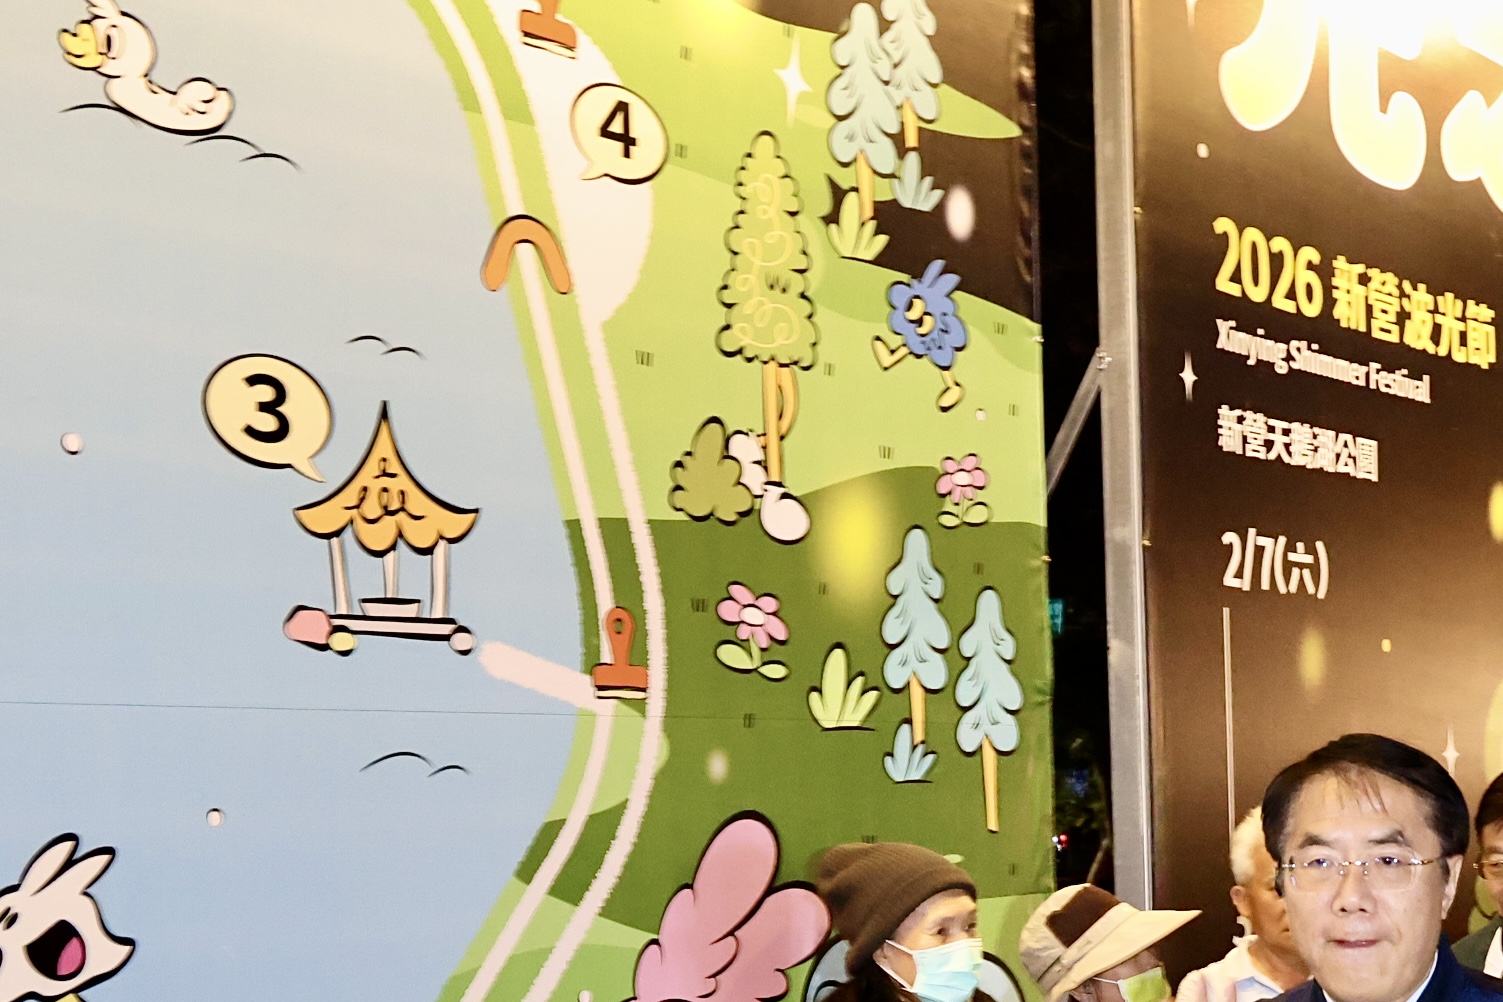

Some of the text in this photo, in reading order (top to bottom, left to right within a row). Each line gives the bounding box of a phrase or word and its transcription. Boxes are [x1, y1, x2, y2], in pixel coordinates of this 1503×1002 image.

[600, 100, 637, 159] 4
[1212, 216, 1497, 370] 2026 新營波光節
[1215, 318, 1431, 404] Xinying Shimmer Festival
[241, 373, 290, 443] 3
[1220, 527, 1330, 599] 2/7(六)
